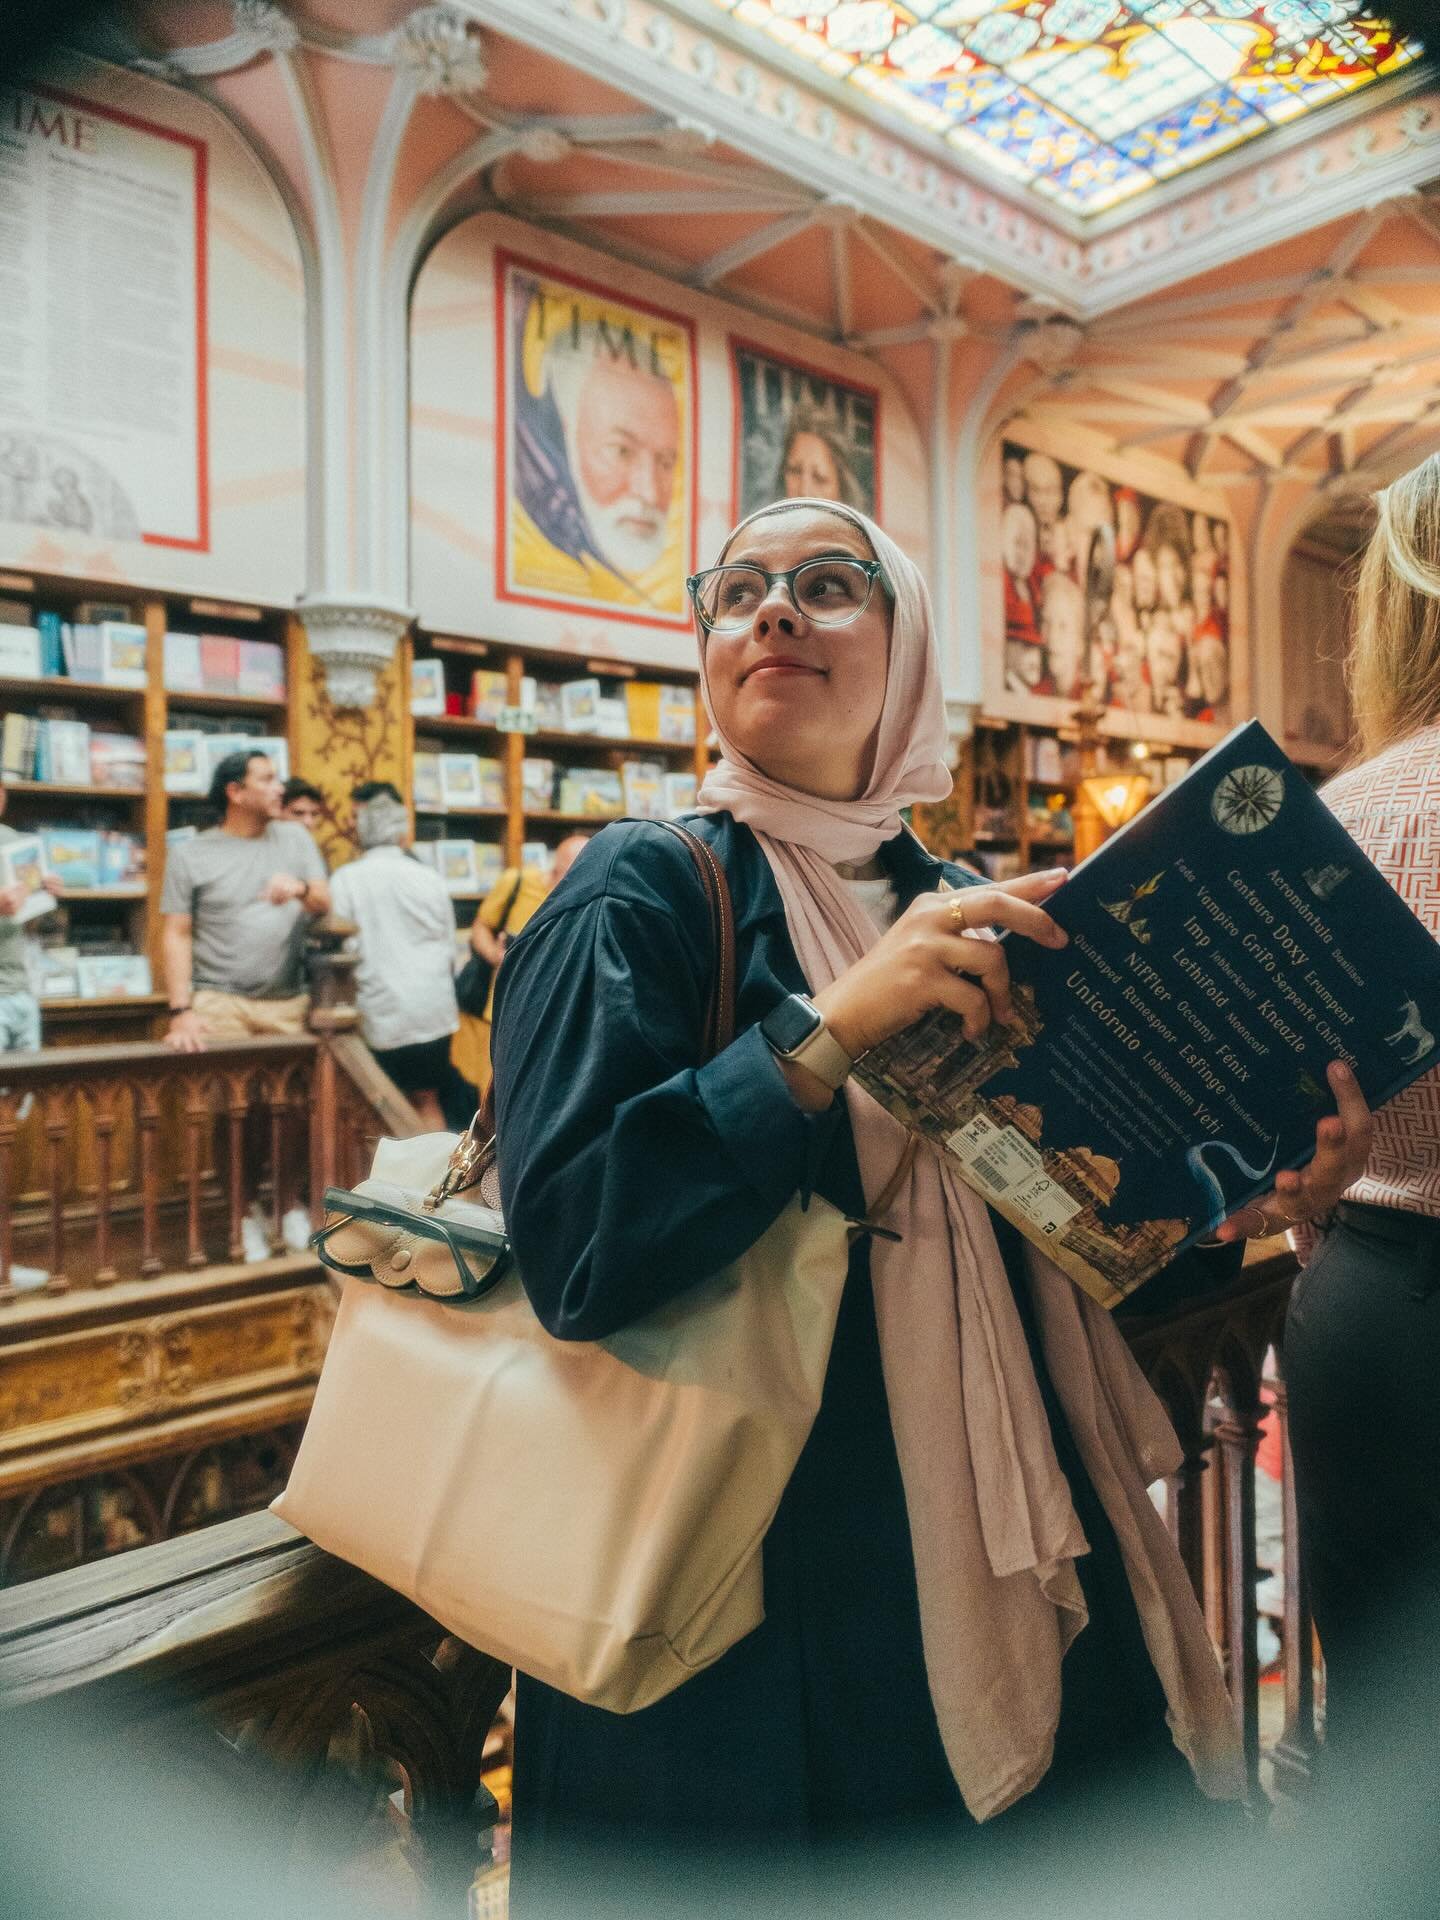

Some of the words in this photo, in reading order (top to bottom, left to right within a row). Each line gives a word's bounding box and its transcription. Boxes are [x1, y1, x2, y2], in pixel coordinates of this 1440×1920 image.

[13, 96, 97, 156] IME
[525, 282, 681, 383] TIME
[1172, 947, 1230, 1008] Lethifold
[1225, 1012, 1270, 1056] Mooncalf
[1174, 858, 1196, 883] Fada
[1196, 885, 1240, 937] Vampiro
[1242, 933, 1276, 972] Grifo
[1271, 972, 1317, 1022] Serpente
[1315, 1020, 1359, 1069] Chifruda
[1183, 915, 1211, 947] Imp
[1257, 999, 1306, 1053] Kneazle
[1227, 869, 1275, 925] Centauro
[1272, 924, 1310, 966] Doxy
[1303, 970, 1355, 1026] Erumpent
[1331, 948, 1365, 987] Basilisco
[1066, 970, 1141, 1050] Unicórnio
[1142, 1050, 1195, 1107] Lobisomem
[1192, 1103, 1224, 1135] Yeti
[1074, 934, 1123, 984] Quintaped
[1121, 985, 1177, 1043] Runespoor
[1178, 1043, 1226, 1095] Esfinge
[1224, 1092, 1272, 1143] Thunderbird
[1123, 951, 1172, 1001] Niffler
[1177, 1000, 1217, 1043] Occamy
[1215, 1044, 1251, 1082] Fénix
